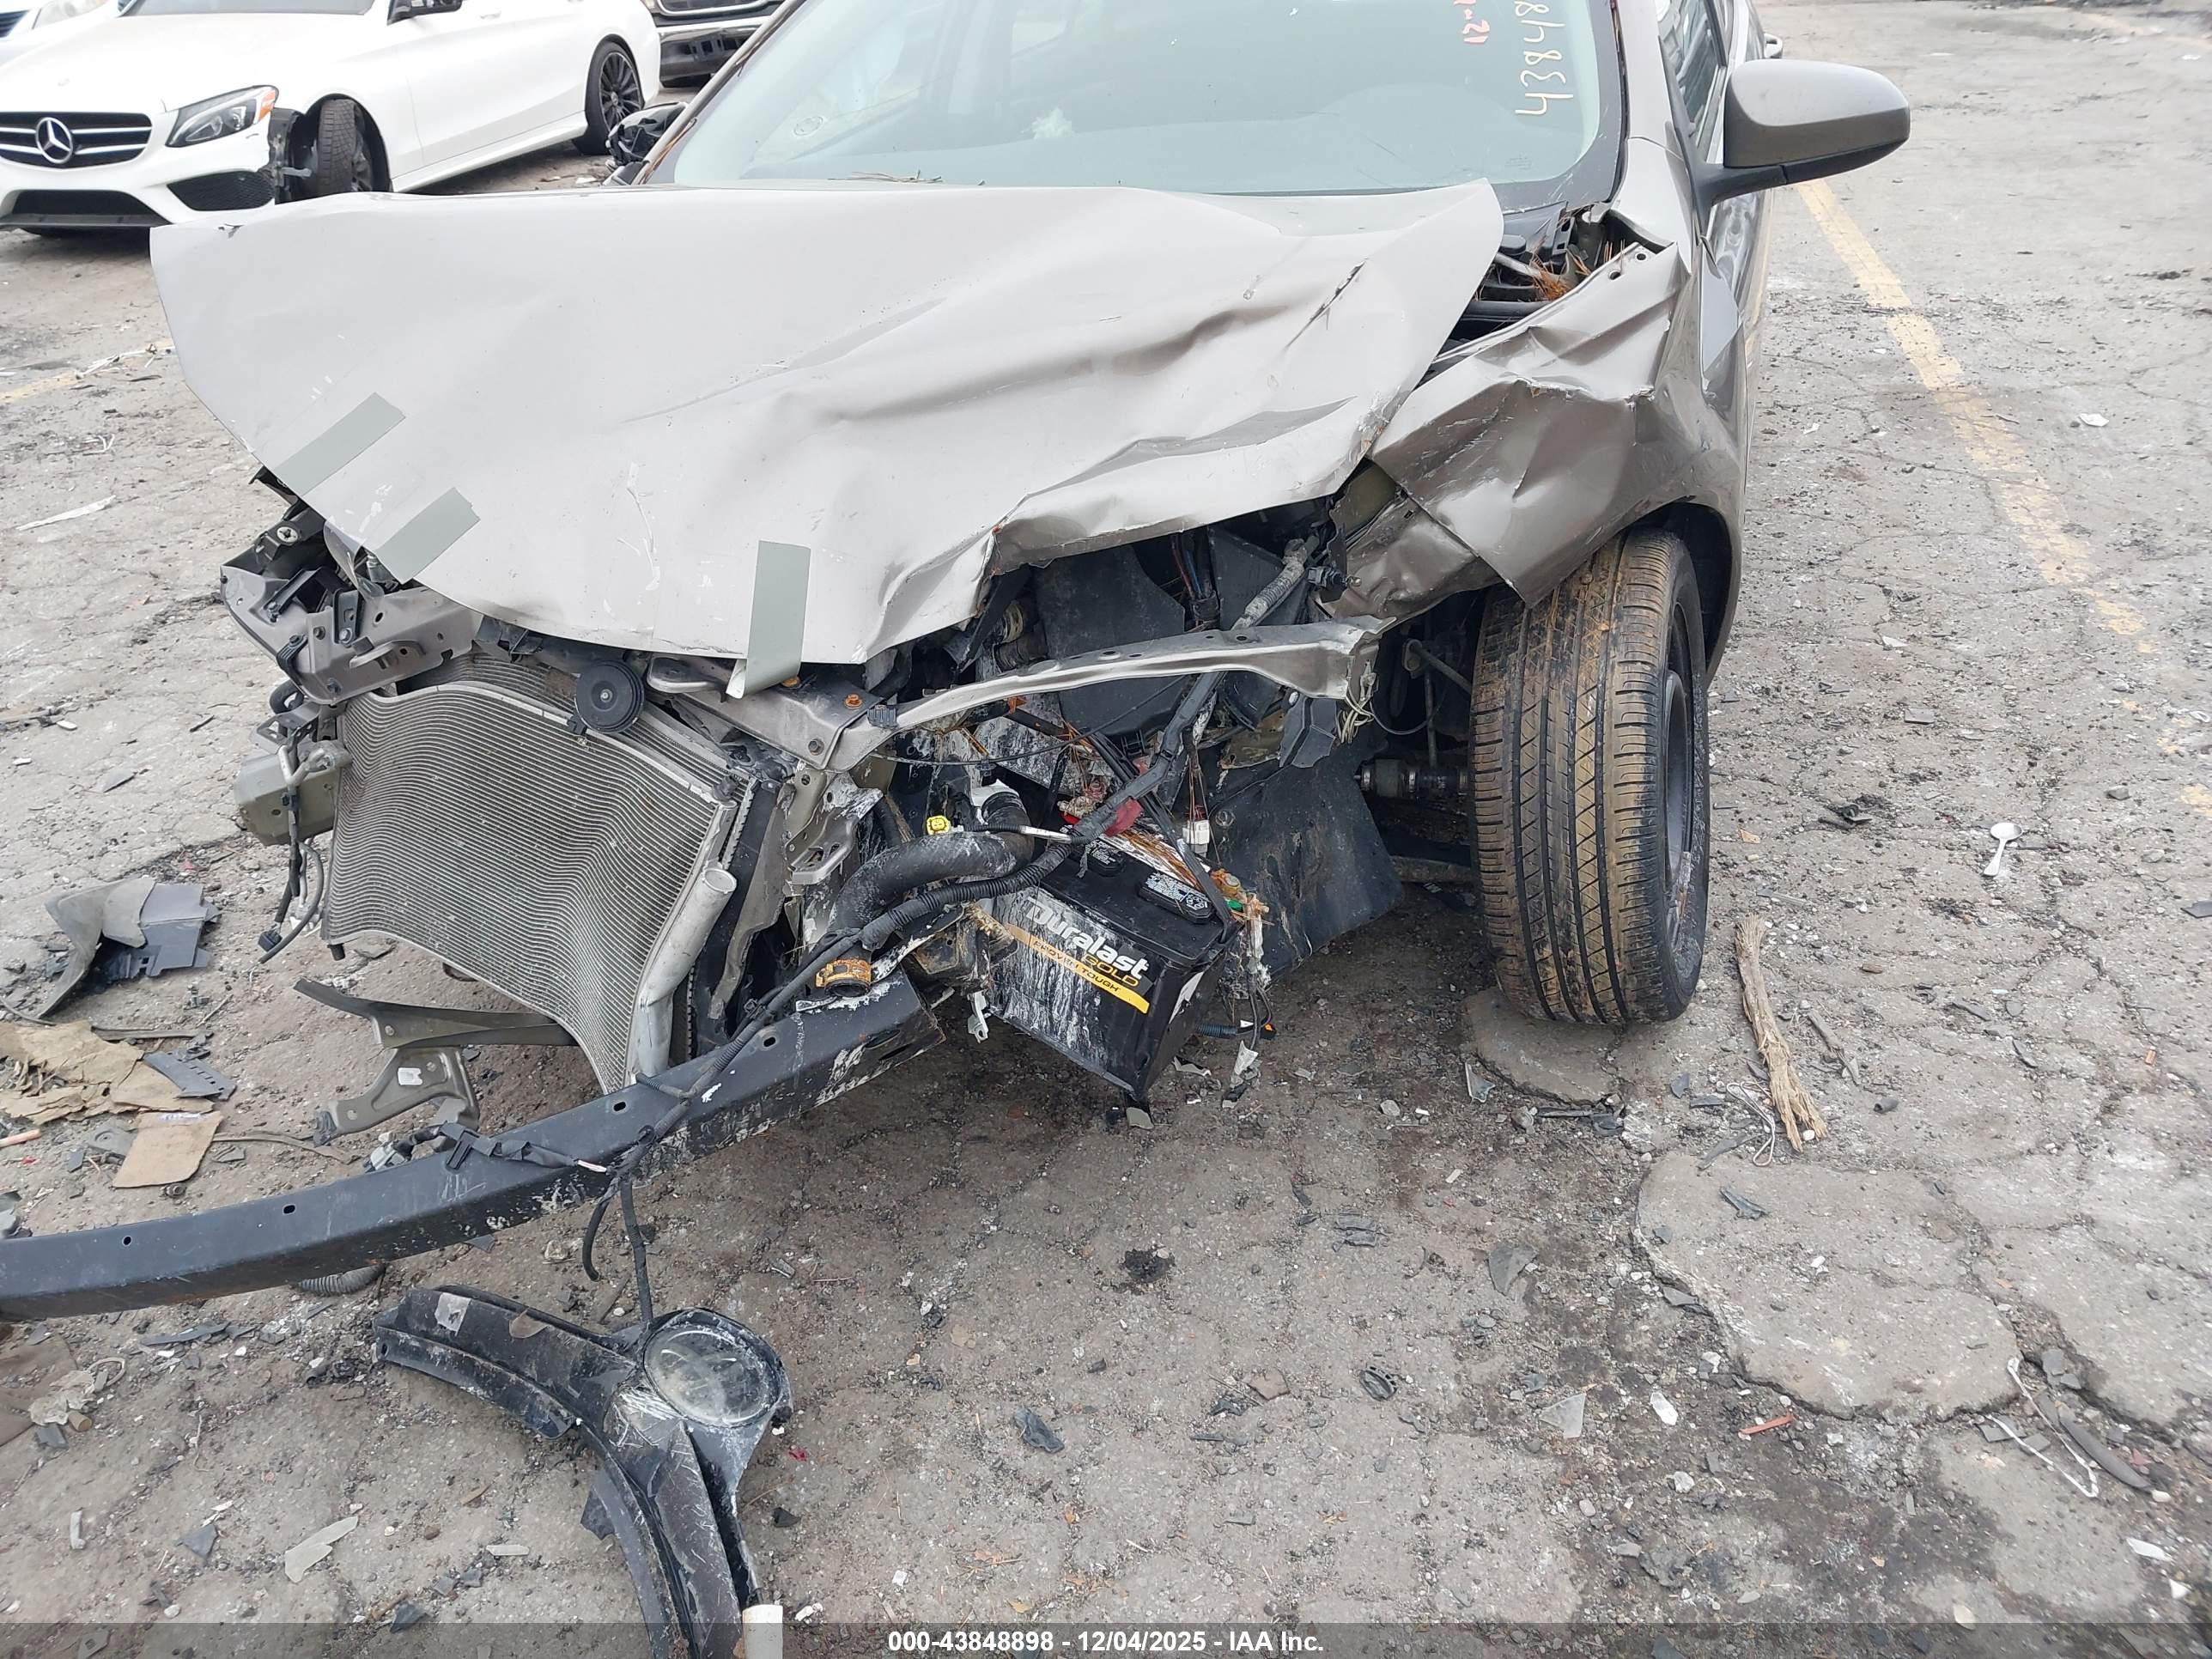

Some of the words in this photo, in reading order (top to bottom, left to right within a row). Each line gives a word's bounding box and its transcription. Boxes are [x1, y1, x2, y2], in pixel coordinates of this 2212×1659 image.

[1026, 896, 1150, 980] Duralast
[1081, 967, 1120, 992] TOUGH
[1083, 954, 1139, 987] GOLD
